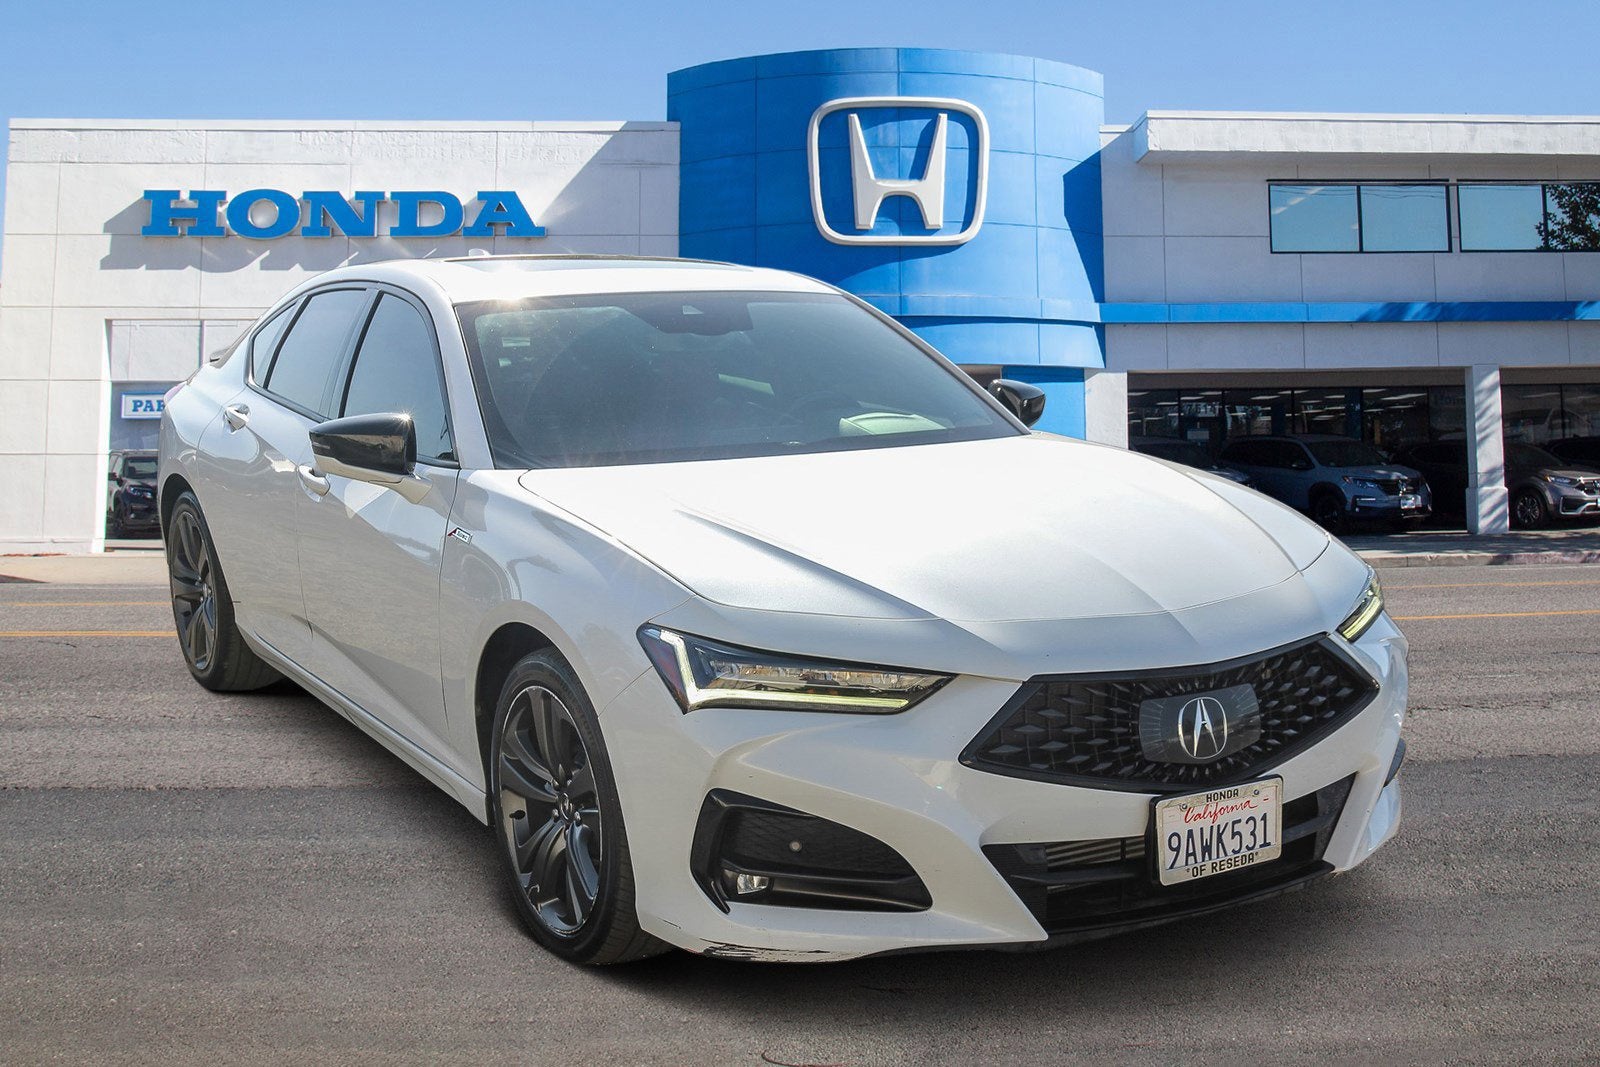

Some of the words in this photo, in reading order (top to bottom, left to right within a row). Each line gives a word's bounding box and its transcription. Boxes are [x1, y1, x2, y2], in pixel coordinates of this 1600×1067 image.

[141, 188, 548, 240] HONDA
[1206, 788, 1239, 803] HONDA
[1184, 798, 1257, 824] California
[1167, 812, 1272, 870] 9AWK531
[1191, 864, 1207, 878] OF
[1211, 854, 1255, 873] RESEDA
